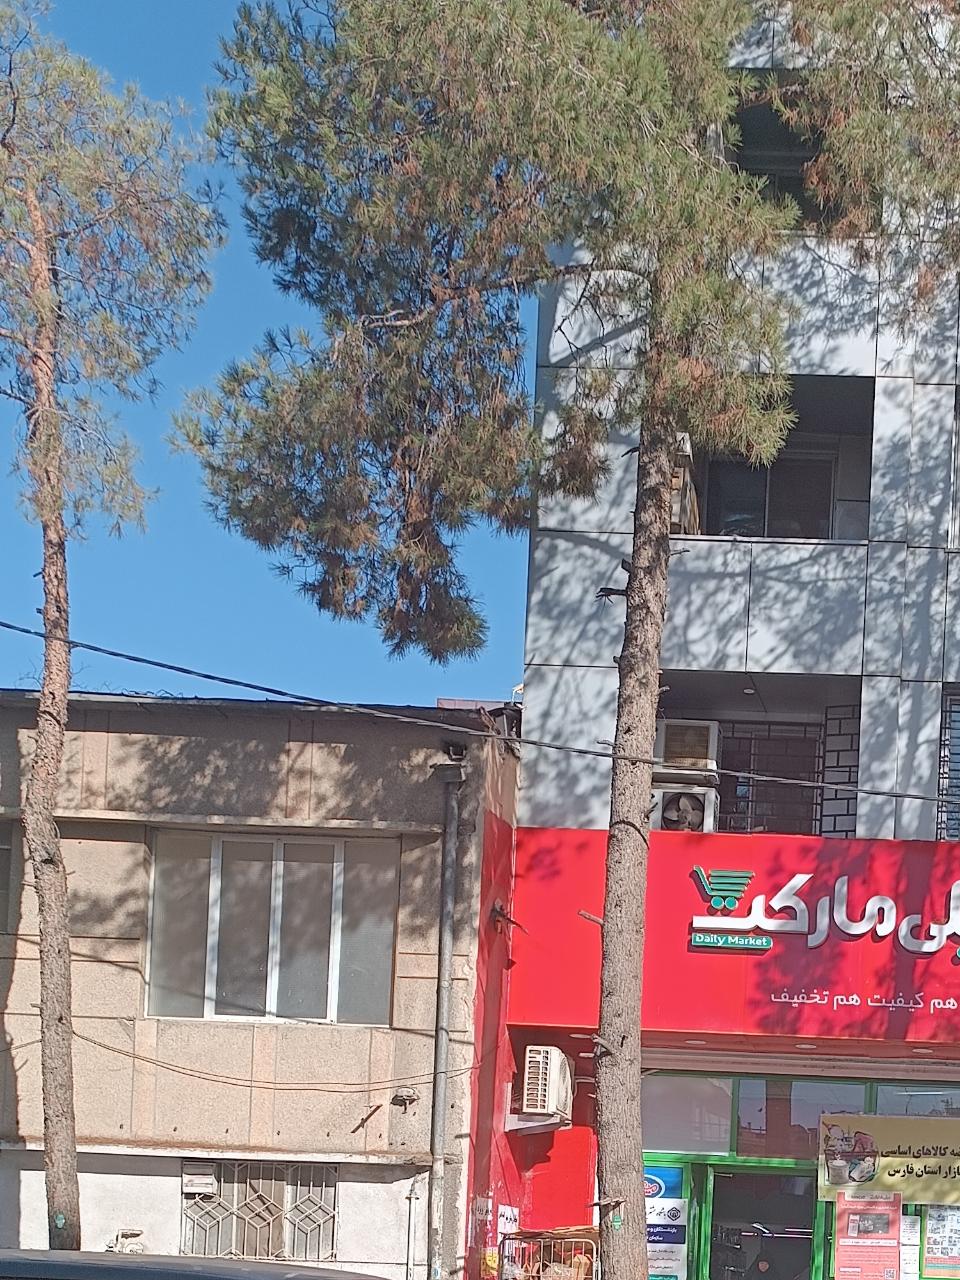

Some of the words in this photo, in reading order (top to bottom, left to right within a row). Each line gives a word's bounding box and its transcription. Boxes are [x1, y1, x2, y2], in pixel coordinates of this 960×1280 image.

[694, 933, 726, 947] Daily
[727, 935, 768, 948] Market
[770, 990, 830, 1006] تخفیف
[832, 992, 861, 1009] هم
[866, 991, 924, 1010] کیفیت
[929, 996, 958, 1010] هم
[880, 1144, 911, 1158] اساسی
[912, 1146, 949, 1159] کالاهای
[887, 1164, 914, 1178] فارس
[914, 1165, 942, 1178] استان
